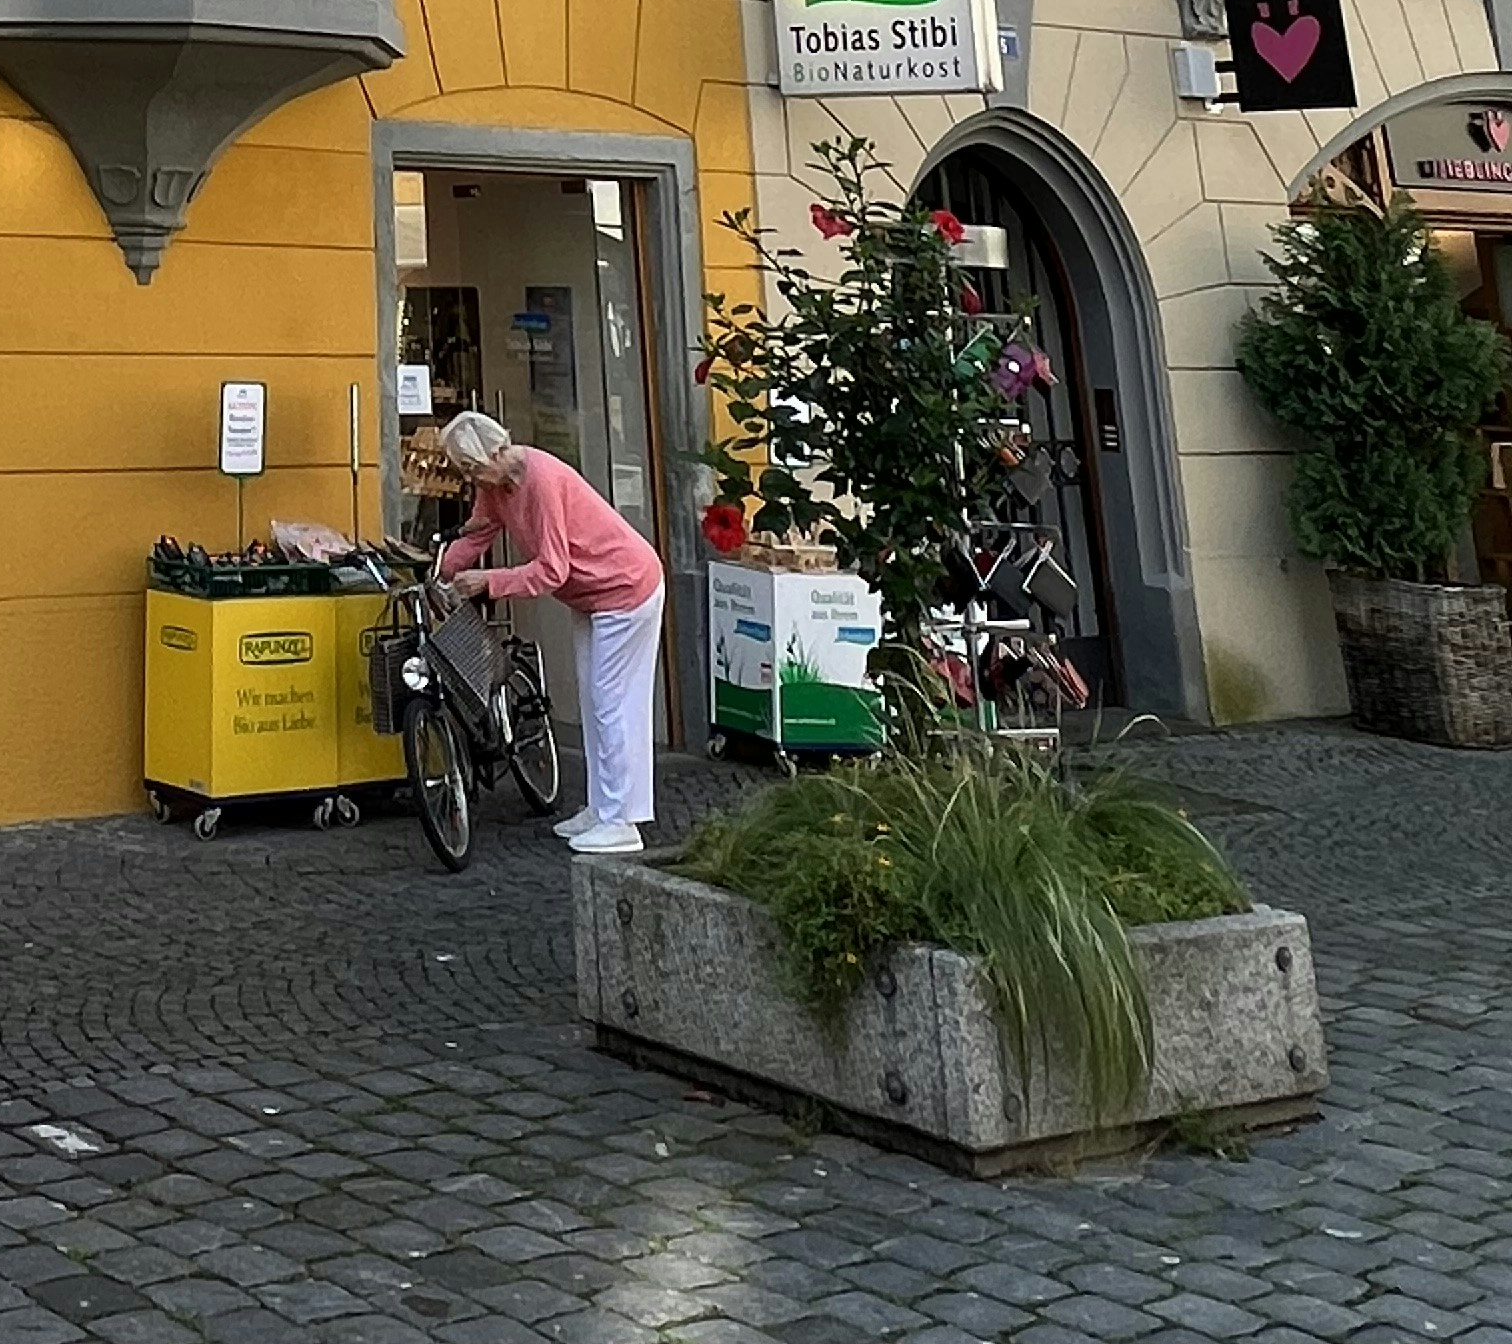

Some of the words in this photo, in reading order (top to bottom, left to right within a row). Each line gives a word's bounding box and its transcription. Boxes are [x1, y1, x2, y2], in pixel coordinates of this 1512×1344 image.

[790, 23, 880, 54] Tobias
[891, 17, 958, 50] Stibi
[793, 56, 962, 83] BioNaturkost
